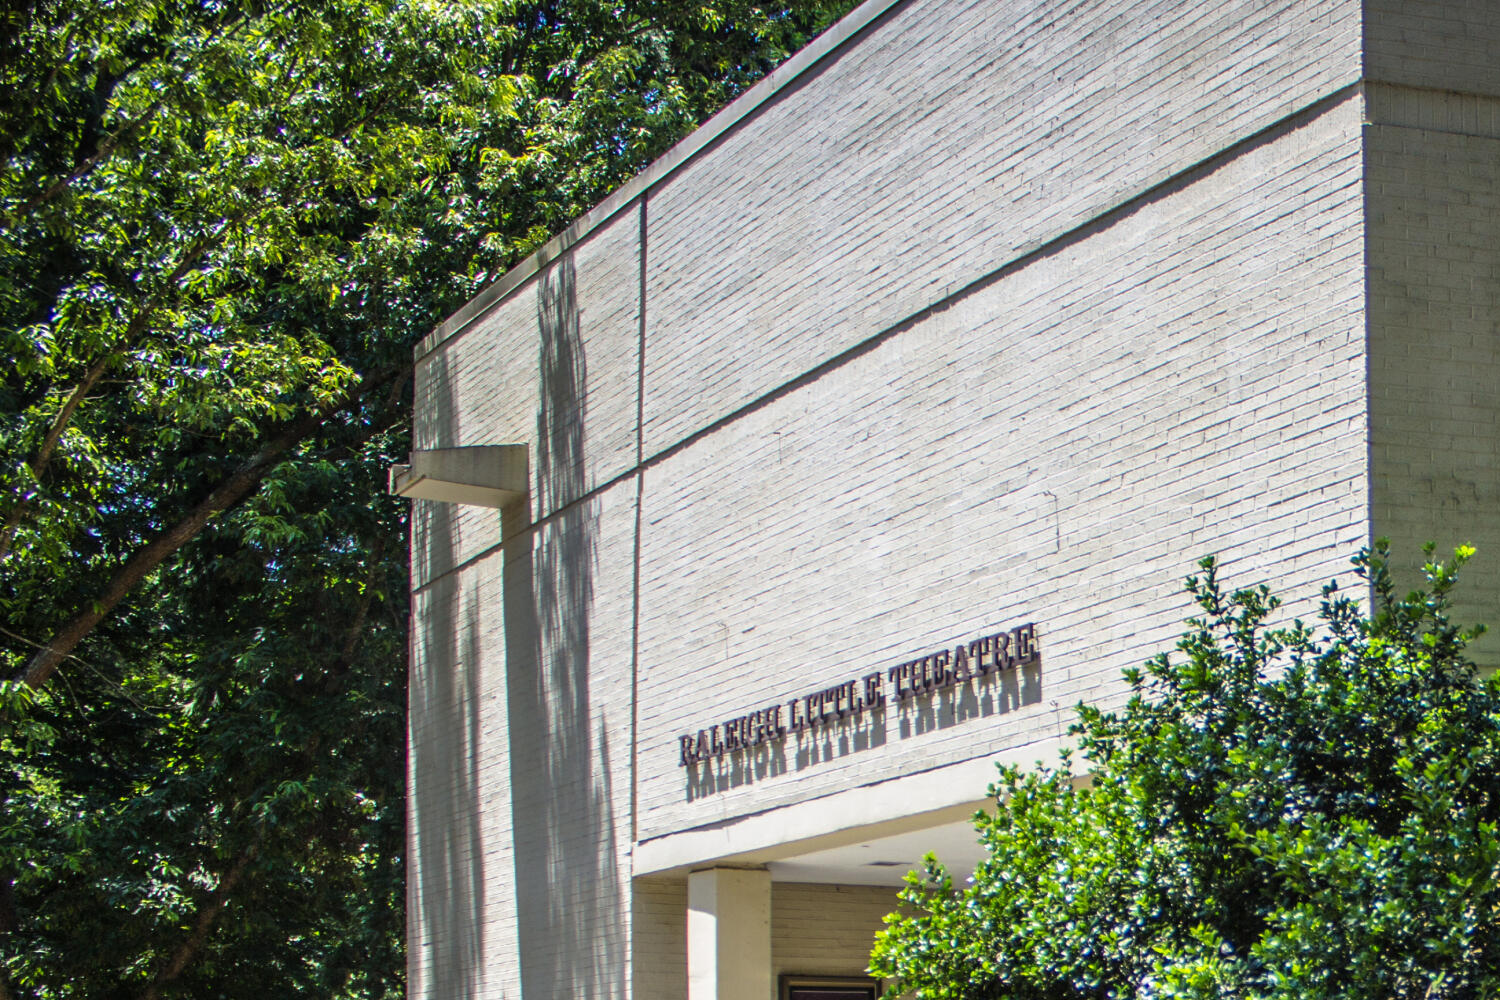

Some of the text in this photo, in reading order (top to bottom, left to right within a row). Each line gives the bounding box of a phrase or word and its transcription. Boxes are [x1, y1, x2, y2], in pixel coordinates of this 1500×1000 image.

[678, 622, 1038, 768] RALEIGH LITTLE THEATRE
